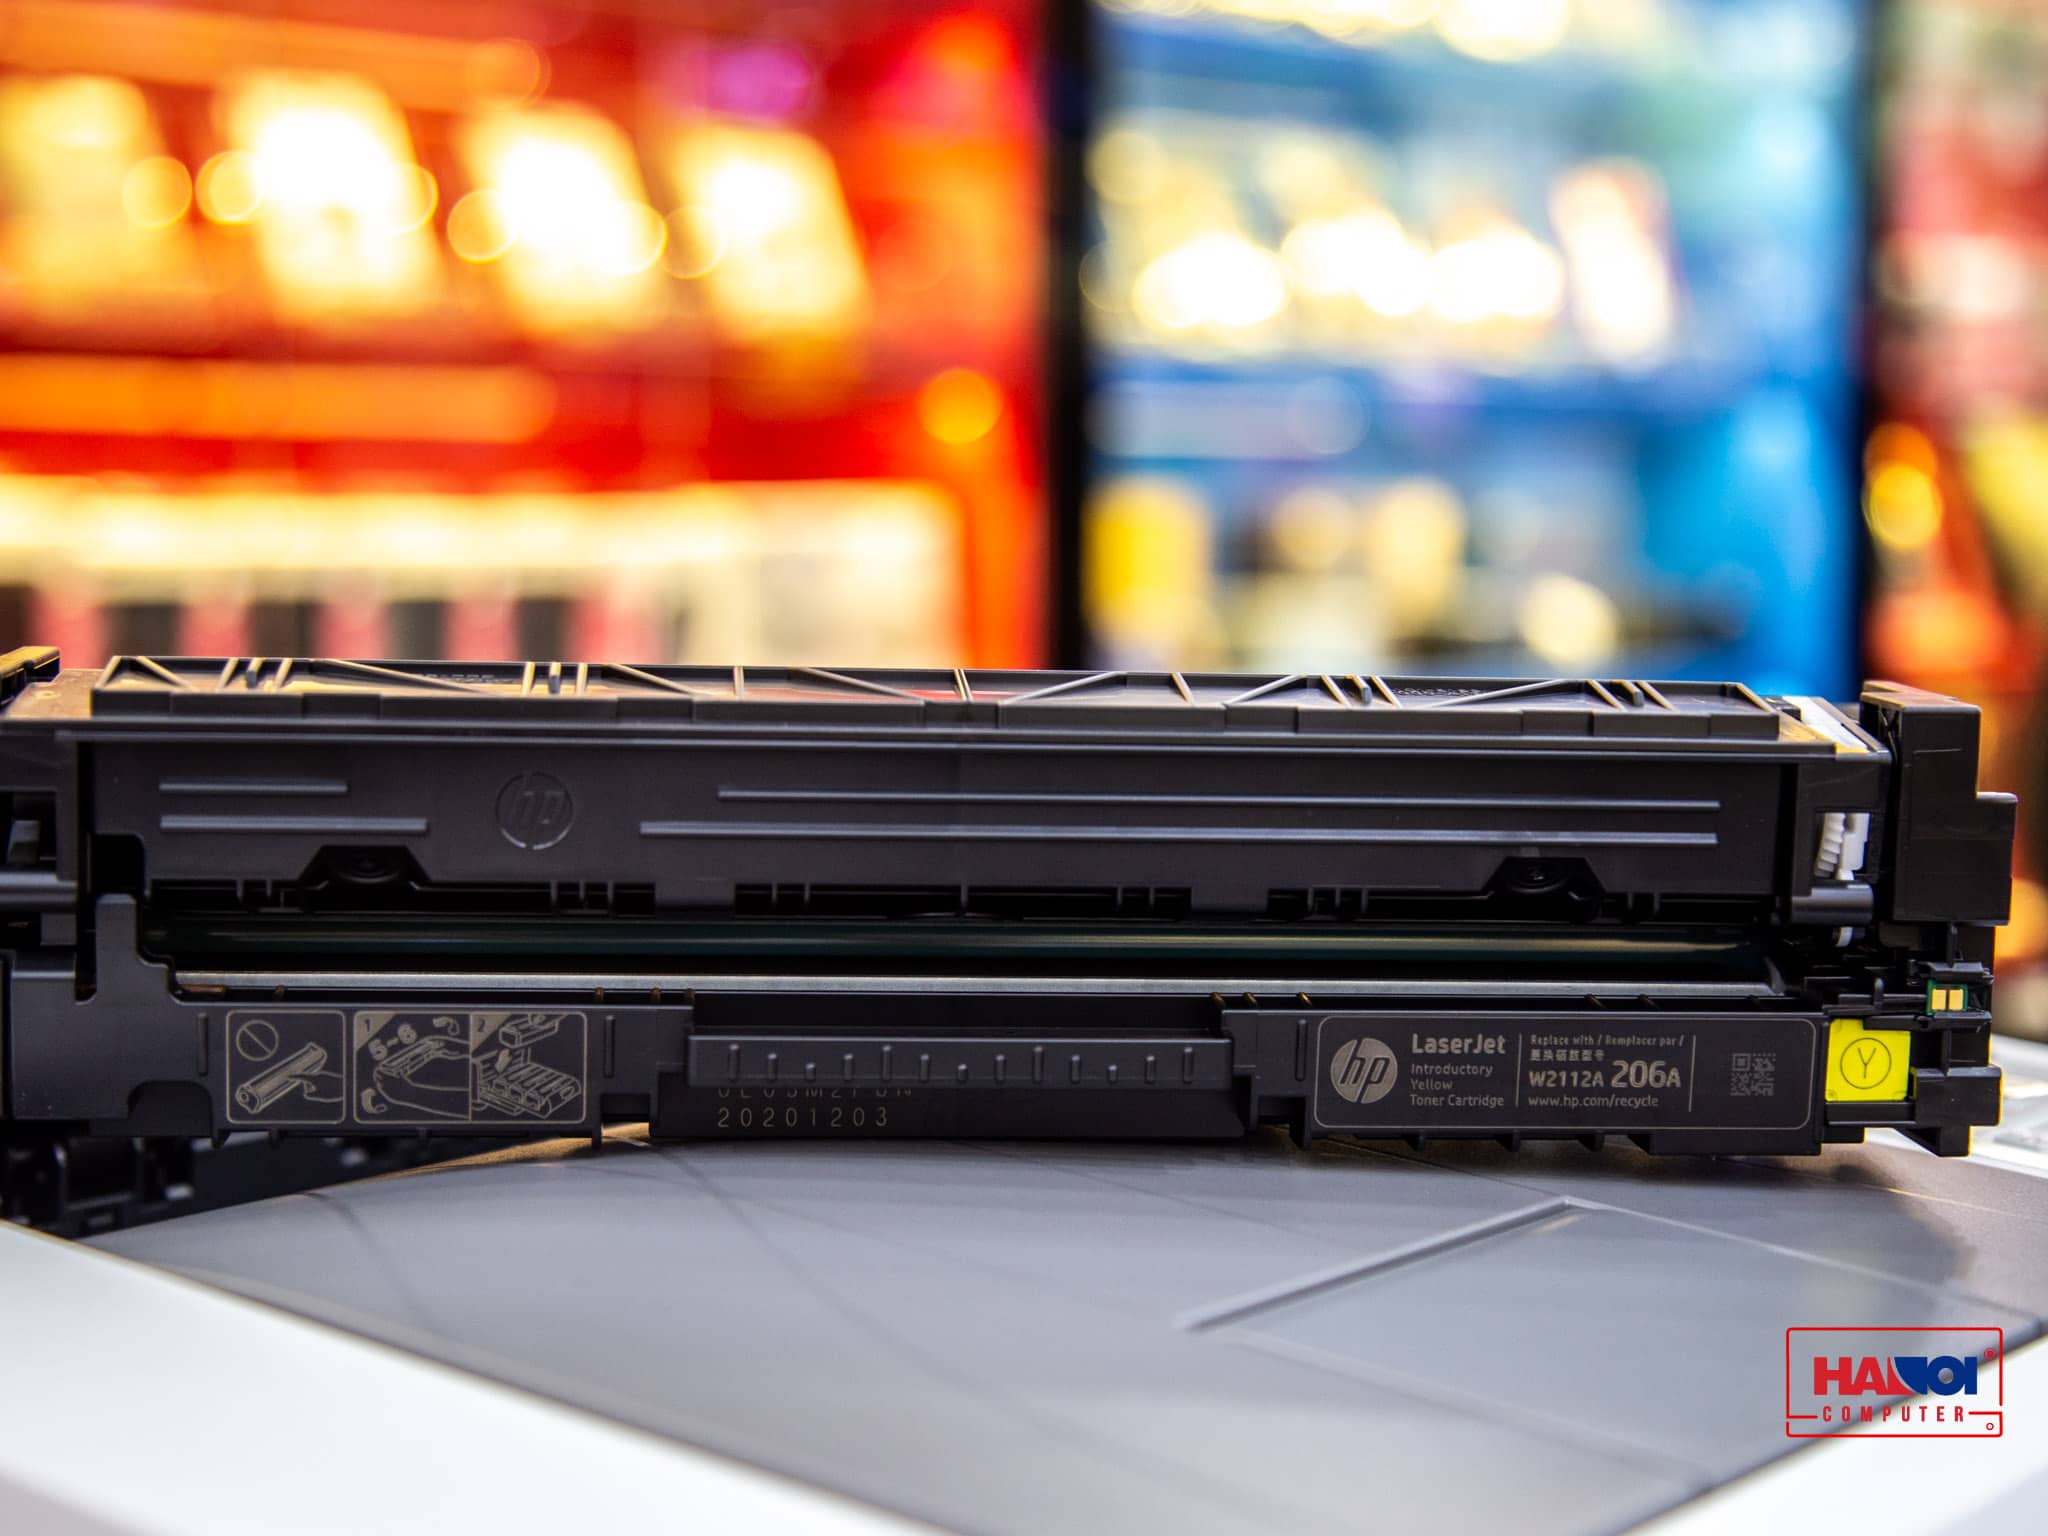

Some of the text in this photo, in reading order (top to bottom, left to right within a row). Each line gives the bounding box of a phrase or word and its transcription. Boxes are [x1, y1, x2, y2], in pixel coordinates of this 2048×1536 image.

[365, 1019, 370, 1032] 1
[479, 1019, 485, 1032] 2
[1411, 1033, 1506, 1054] LaserJet
[1530, 1035, 1569, 1047] Replace
[1572, 1035, 1595, 1045] with
[1605, 1035, 1656, 1047] Remplacer
[1659, 1038, 1676, 1047] par
[1333, 1038, 1395, 1103] hp
[1411, 1063, 1494, 1077] Introductory
[1857, 1048, 1877, 1079] Y
[1529, 1060, 1681, 1089] W2112A 206A
[1410, 1078, 1453, 1090] Yellow
[1409, 1094, 1505, 1108] Toner Cartridge
[1528, 1095, 1659, 1109] www.hp.com/recycle
[717, 1107, 888, 1127] 20201203
